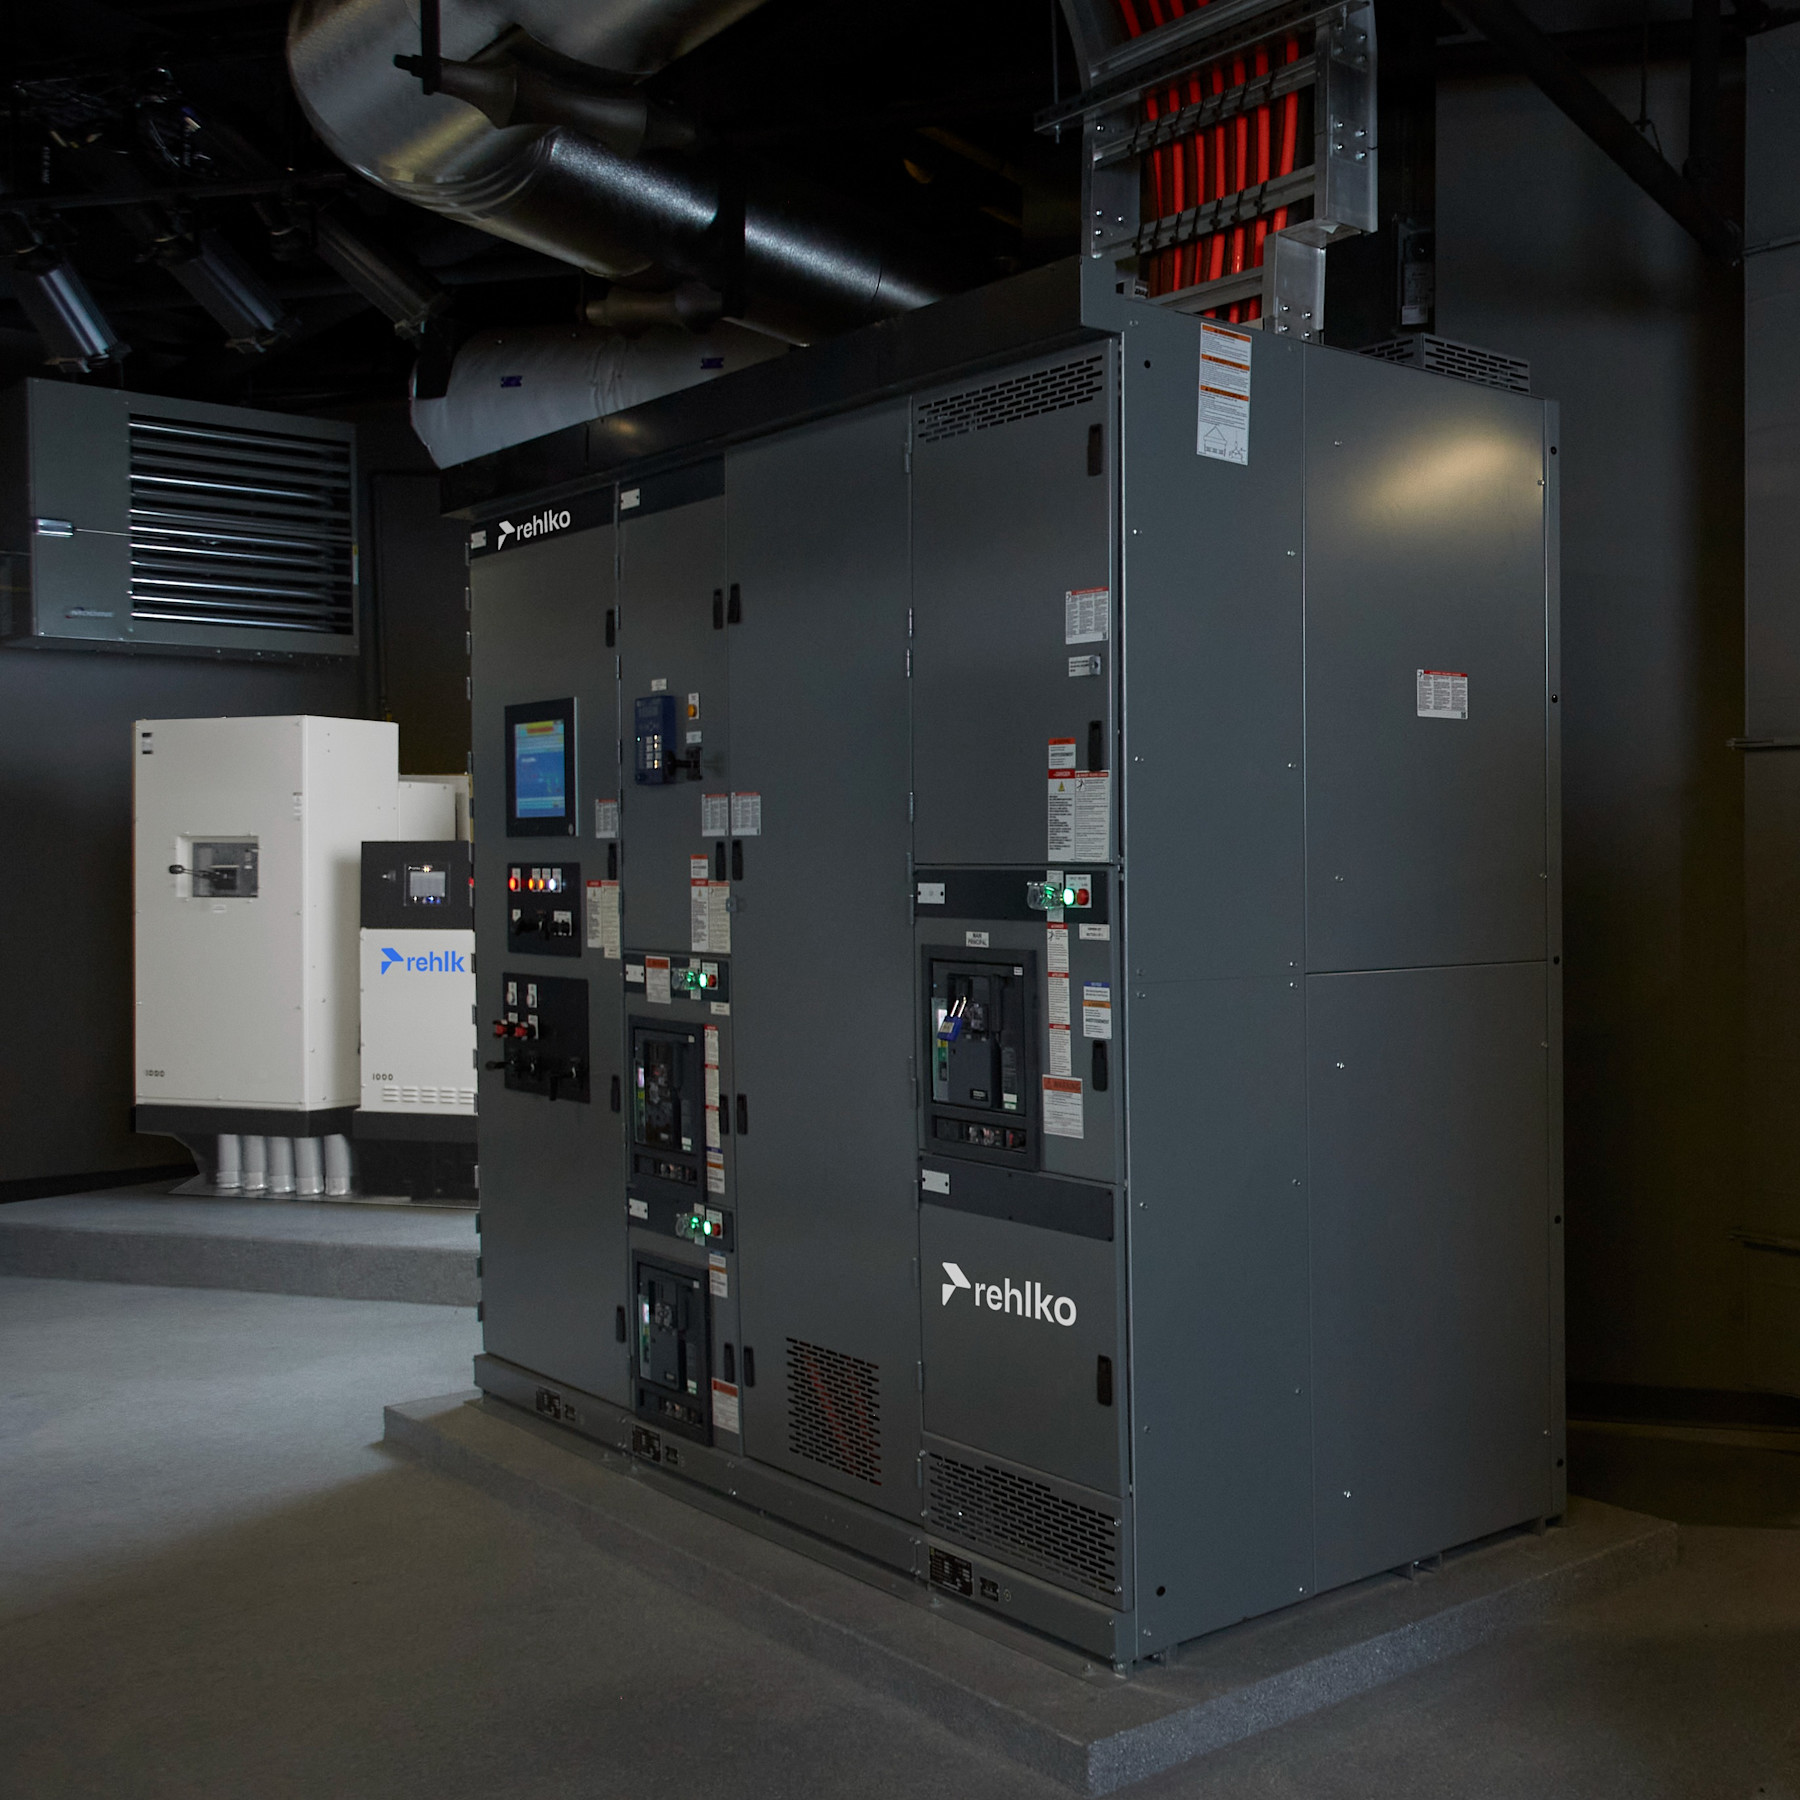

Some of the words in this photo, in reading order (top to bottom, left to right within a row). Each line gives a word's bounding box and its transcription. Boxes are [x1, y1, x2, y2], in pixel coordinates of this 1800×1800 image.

[517, 510, 571, 541] rehlko
[407, 951, 465, 972] rehlk
[372, 1073, 394, 1081] 1000
[974, 1278, 1078, 1327] rehlko
